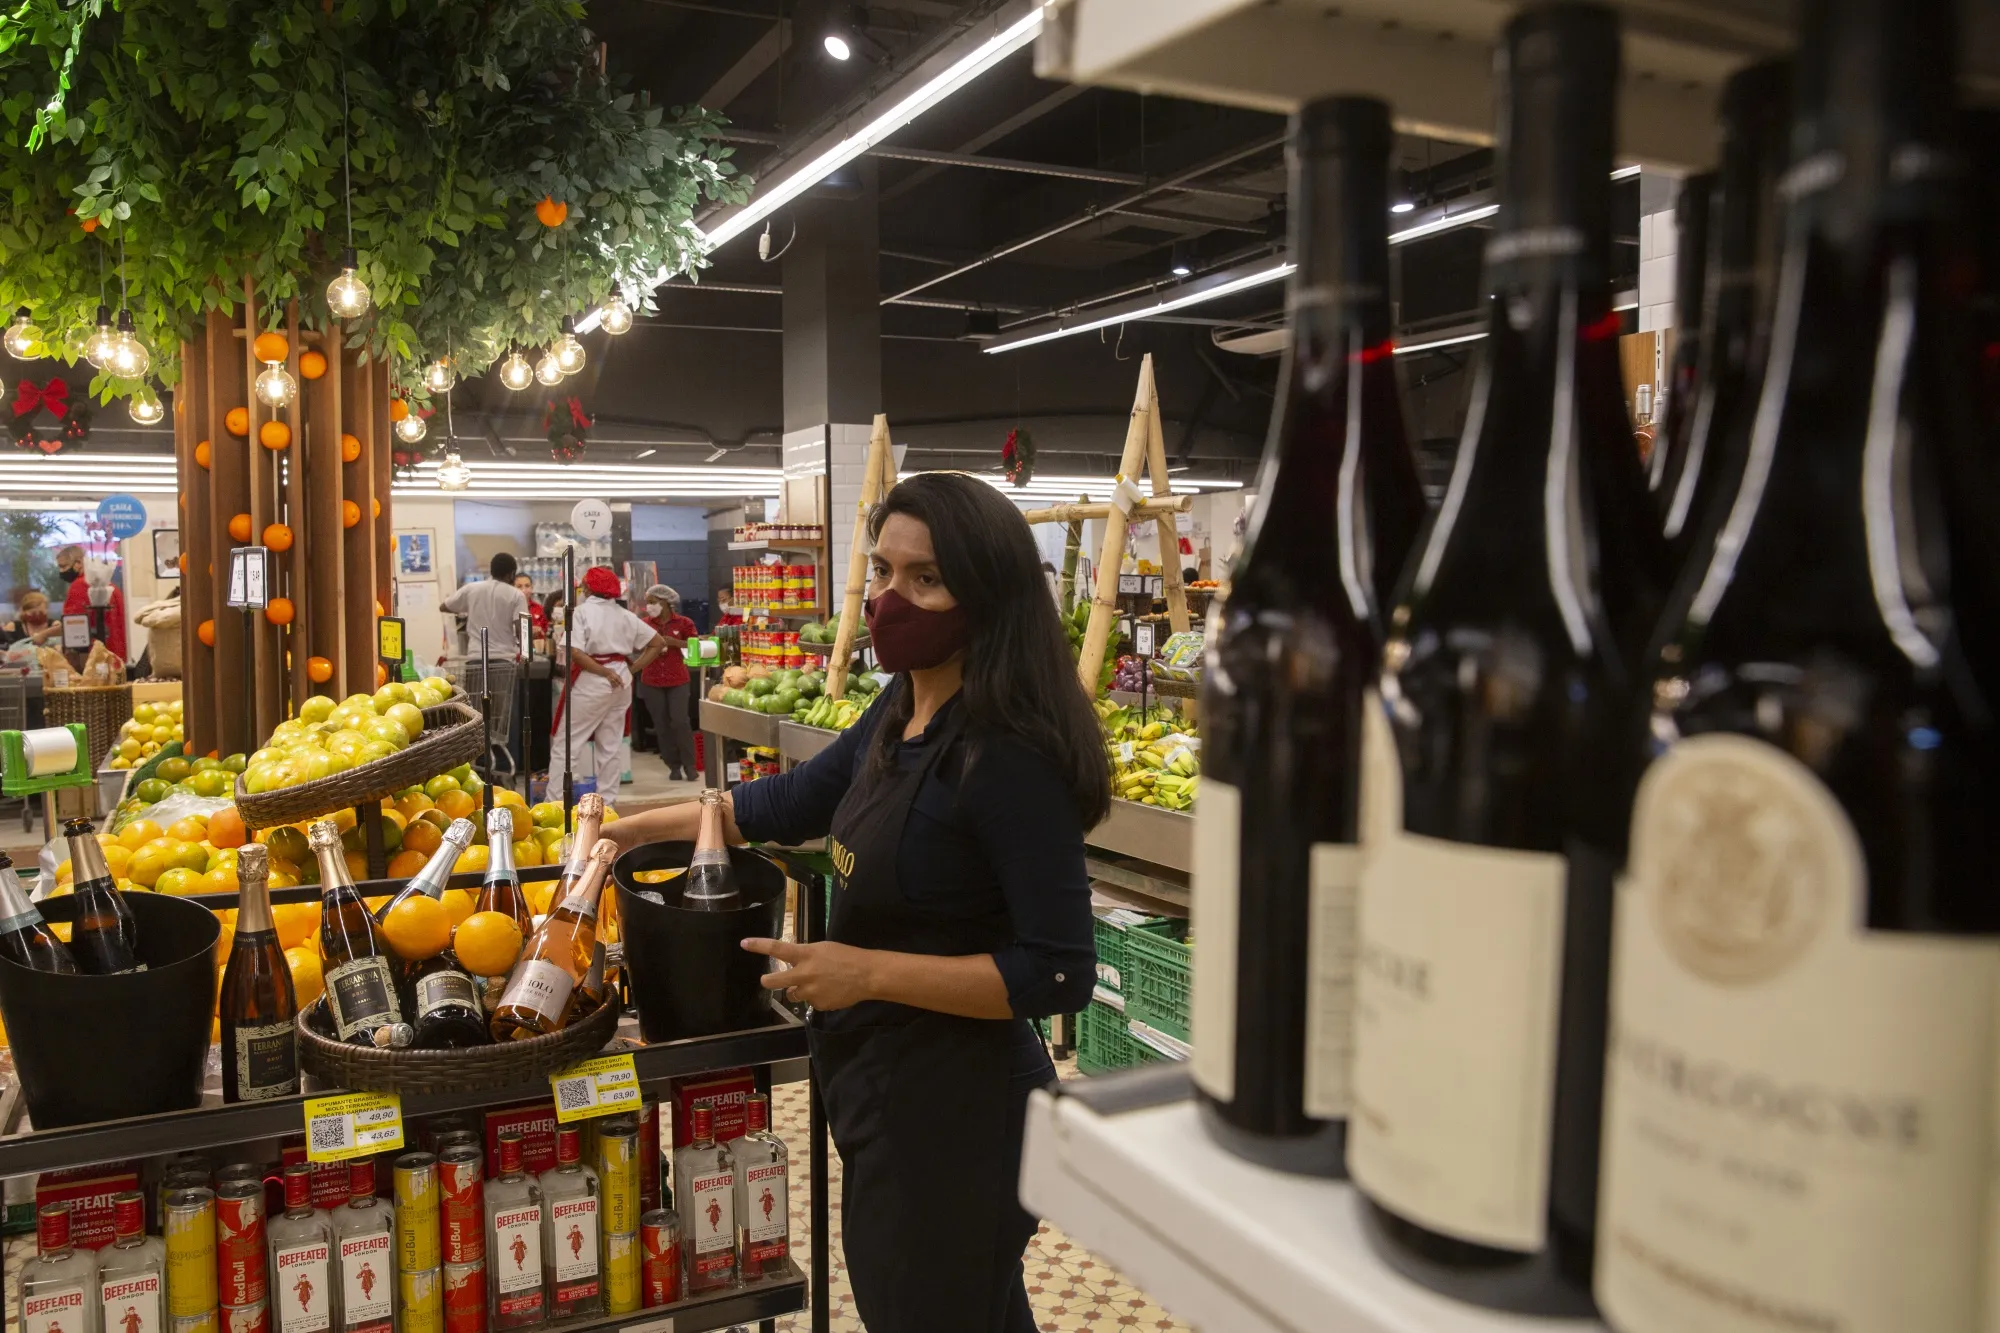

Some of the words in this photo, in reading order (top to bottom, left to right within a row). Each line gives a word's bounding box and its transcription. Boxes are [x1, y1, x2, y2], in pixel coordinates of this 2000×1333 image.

[590, 520, 597, 530] 7
[339, 970, 379, 990] TERRANOVA
[610, 1072, 631, 1082] 79,90
[317, 1099, 352, 1108] ESPUMANTE
[613, 1090, 635, 1100] 63,90
[345, 1100, 381, 1109] TERRANOVA
[313, 1111, 345, 1119] MOSCATEL
[369, 1110, 394, 1121] 49,90
[371, 1129, 396, 1140] 43,65
[748, 1165, 786, 1183] BEEFEATER
[312, 1187, 340, 1196] MUNDO
[695, 1175, 733, 1193] BEEFEATER
[554, 1200, 596, 1219] BEEFEATER
[613, 1193, 623, 1213] Bull
[71, 1222, 89, 1230] MAIS
[497, 1210, 540, 1229] BEEFEATER
[614, 1214, 624, 1231] Red
[71, 1227, 101, 1237] MUNDO
[101, 1225, 114, 1233] CO
[404, 1229, 415, 1249] Bull
[450, 1222, 461, 1243] Bull
[342, 1237, 389, 1257] BEEFEATER
[451, 1243, 462, 1262] Red
[279, 1248, 328, 1269] BEEFEATER
[406, 1250, 416, 1270] Red
[232, 1261, 245, 1283] Bull
[104, 1278, 158, 1301] BEEFEATER
[118, 1292, 145, 1300] LONDON
[234, 1284, 246, 1305] Red
[26, 1293, 83, 1316] BEEFEATER
[41, 1307, 69, 1316] LONDON
